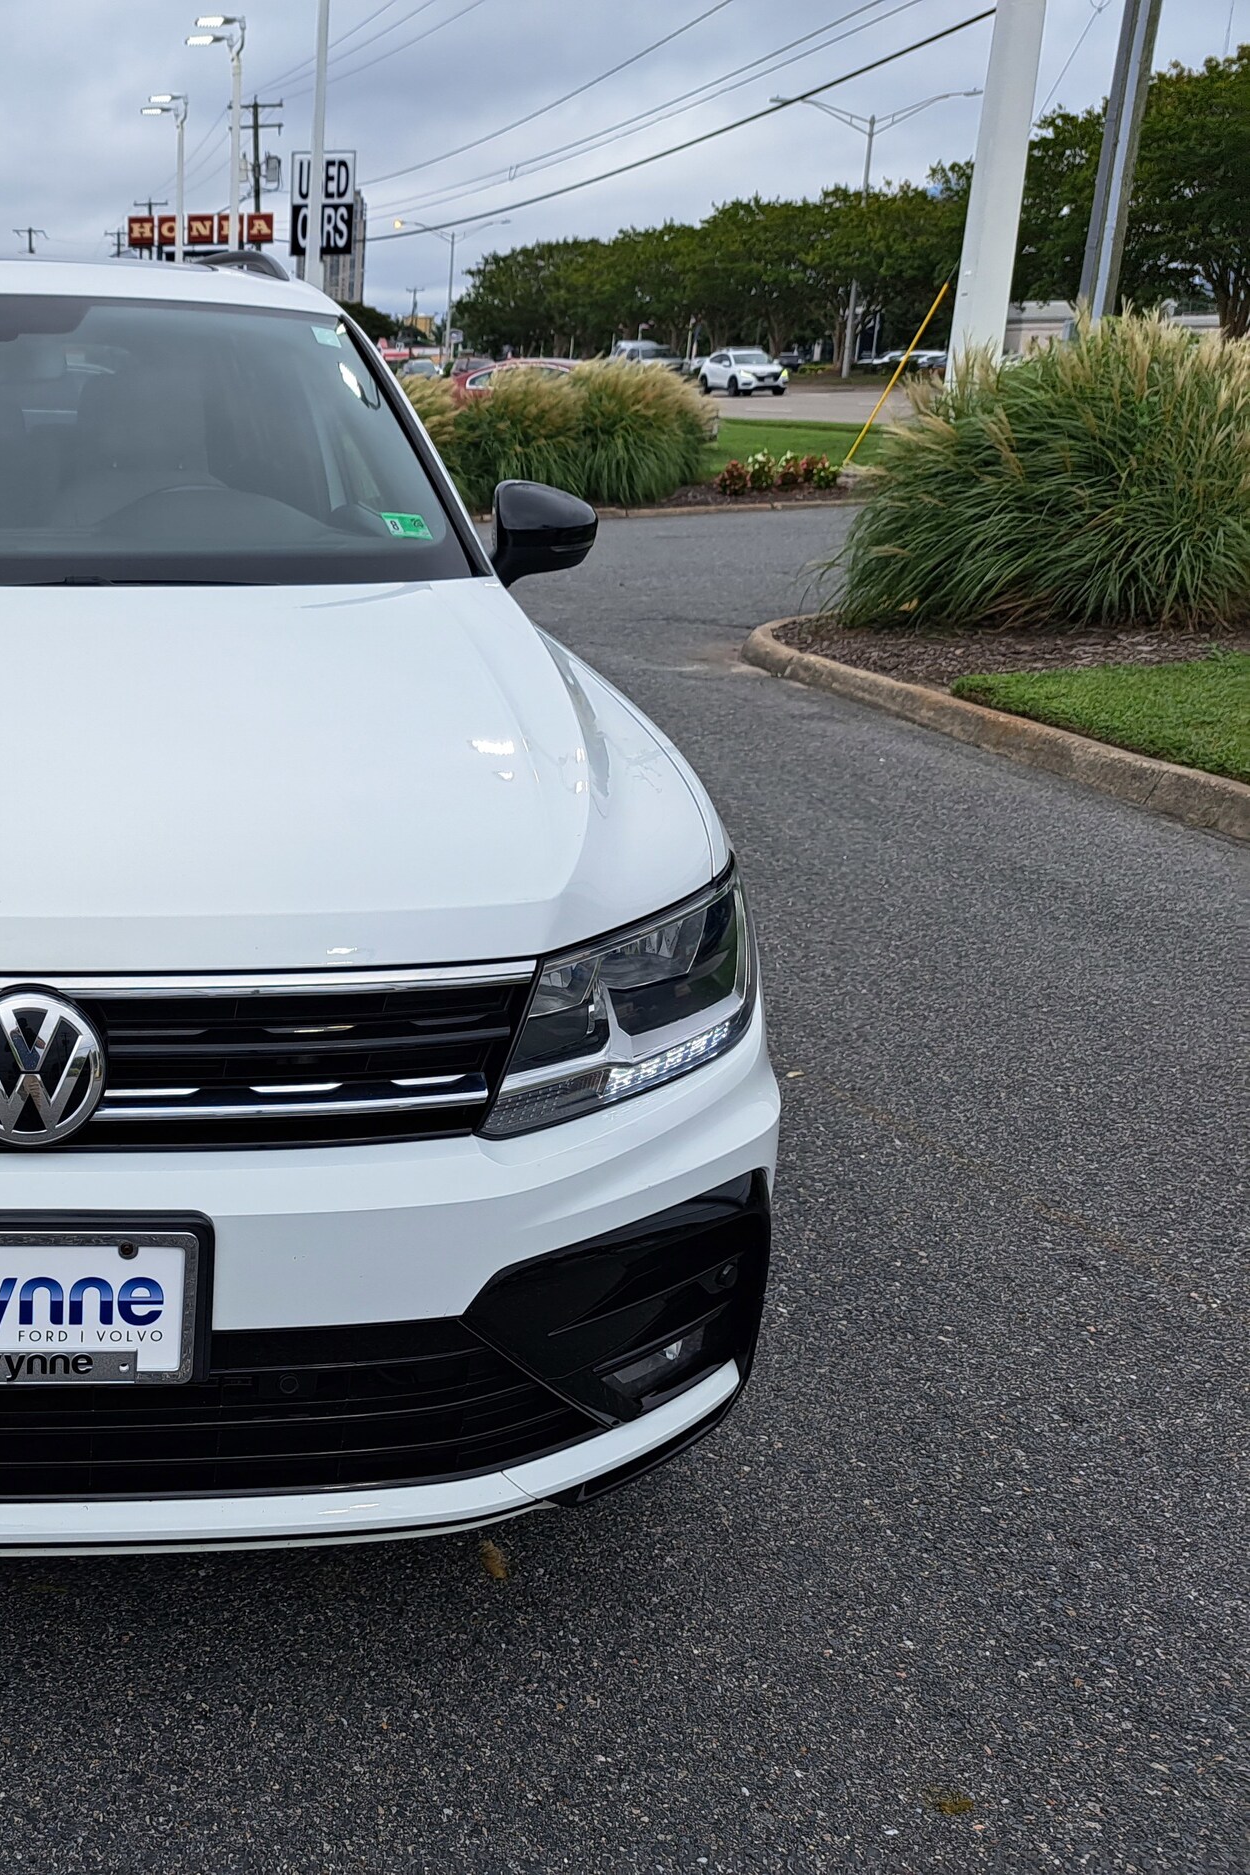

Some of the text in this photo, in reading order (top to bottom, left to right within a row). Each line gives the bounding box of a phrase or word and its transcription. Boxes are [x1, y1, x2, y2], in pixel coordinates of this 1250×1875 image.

[298, 160, 349, 199] UED
[297, 206, 348, 248] CRS
[18, 1330, 164, 1343] FORD VOLVO
